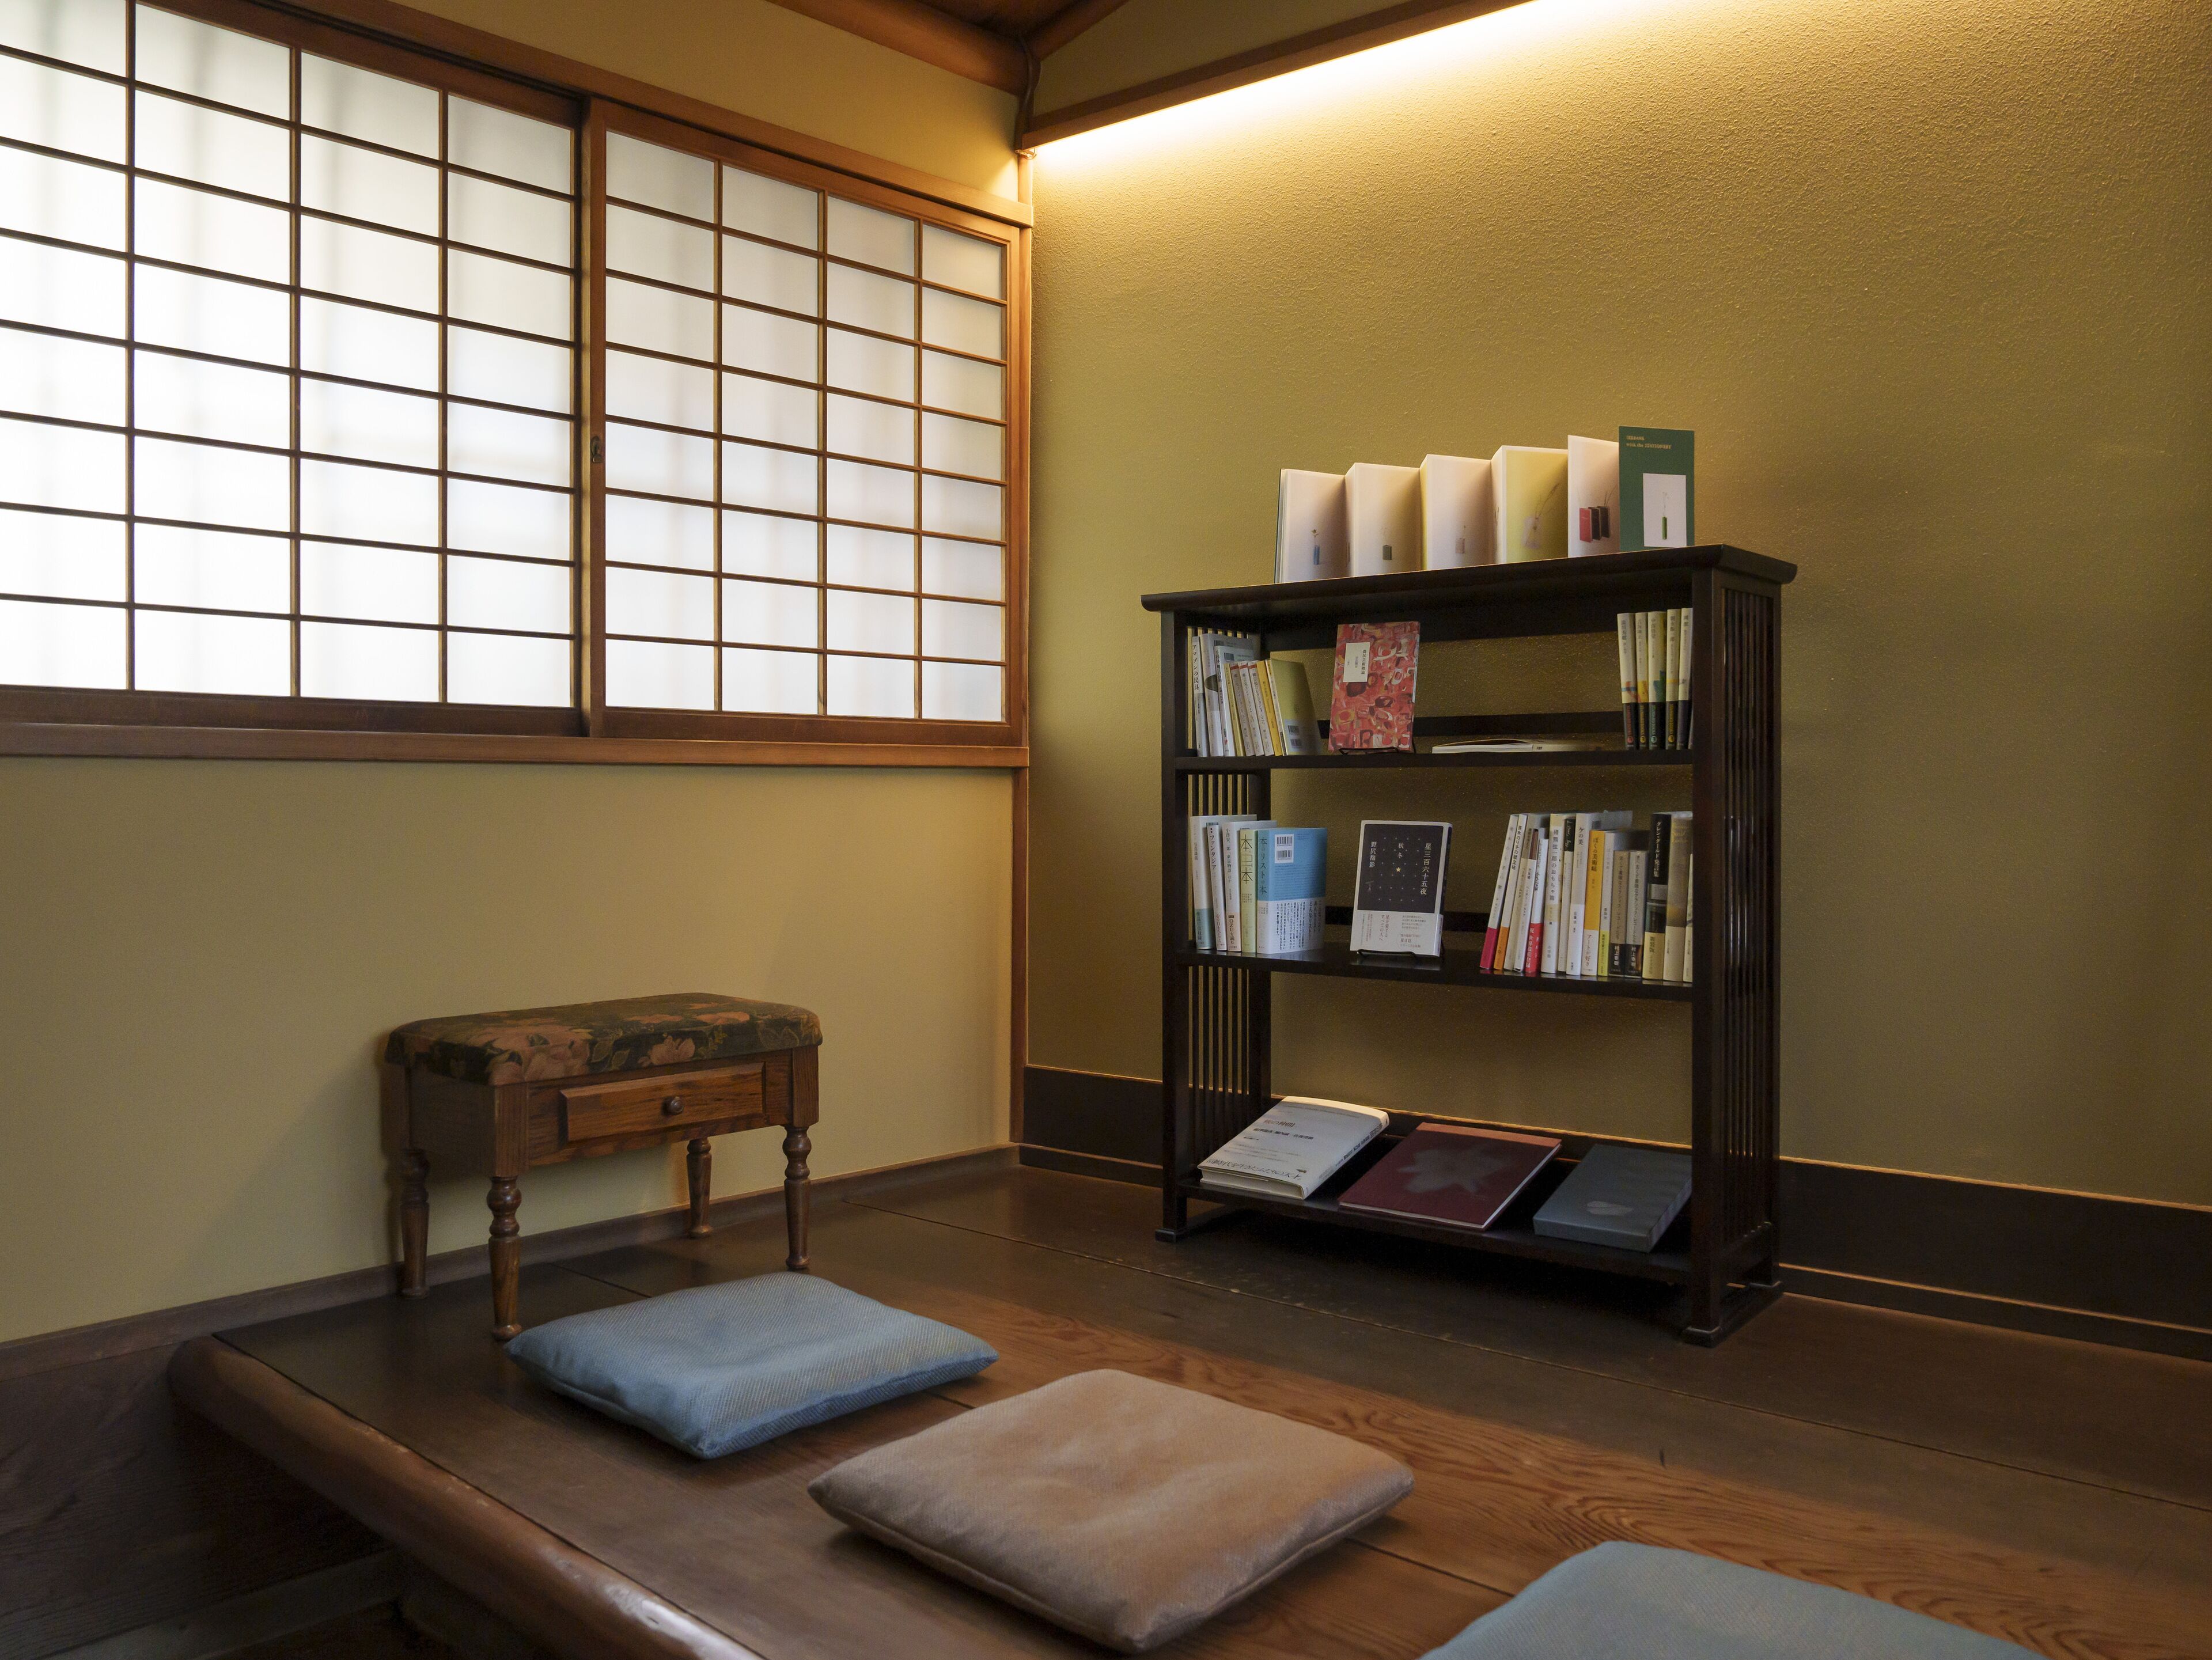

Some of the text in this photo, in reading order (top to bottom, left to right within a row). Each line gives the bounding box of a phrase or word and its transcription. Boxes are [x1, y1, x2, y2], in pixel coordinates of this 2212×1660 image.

[1259, 836, 1267, 895] 本のリストの本
[1369, 841, 1377, 868] 野尻抱影
[1420, 843, 1431, 895] 星三百六十五夜
[1550, 829, 1559, 901] 猪熊弦一郎のおもちゃ箱
[1653, 821, 1662, 877] グレン・グールド発言集
